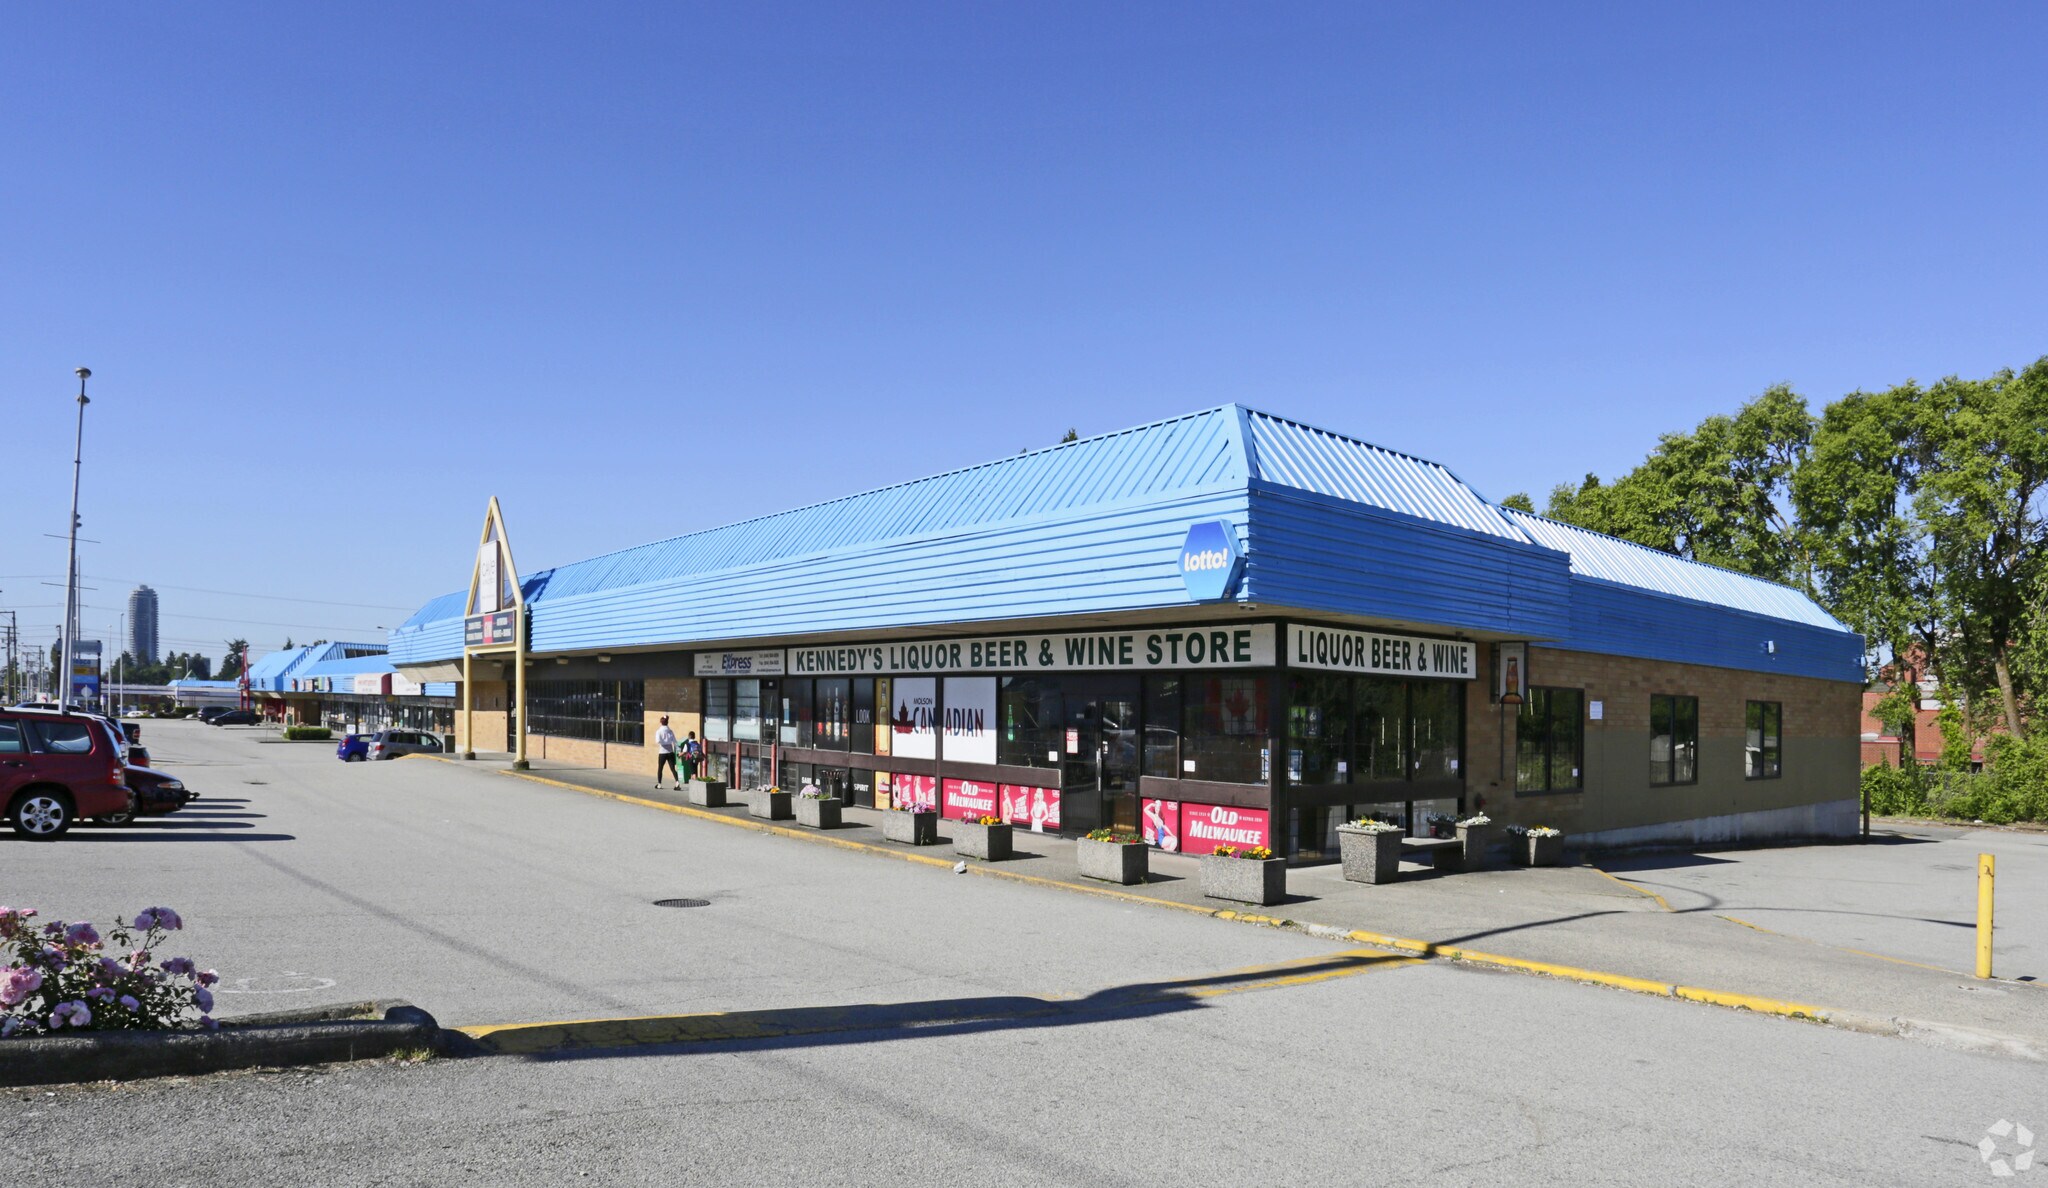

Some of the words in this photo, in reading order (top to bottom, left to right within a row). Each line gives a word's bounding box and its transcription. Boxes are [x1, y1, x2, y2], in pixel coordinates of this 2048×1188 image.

[1184, 548, 1228, 571] lotto!
[796, 647, 883, 672] KENNEDY'S
[890, 643, 960, 670] LIQUOR
[971, 640, 1028, 668] BEER
[1039, 638, 1054, 666] &
[1065, 635, 1133, 665] WINE
[1147, 630, 1252, 664] STORE
[1298, 630, 1364, 667] LIQUOR
[1371, 637, 1411, 670] BEER
[1417, 642, 1427, 672] &
[1433, 645, 1468, 674] WINE
[855, 709, 870, 723] LOOK
